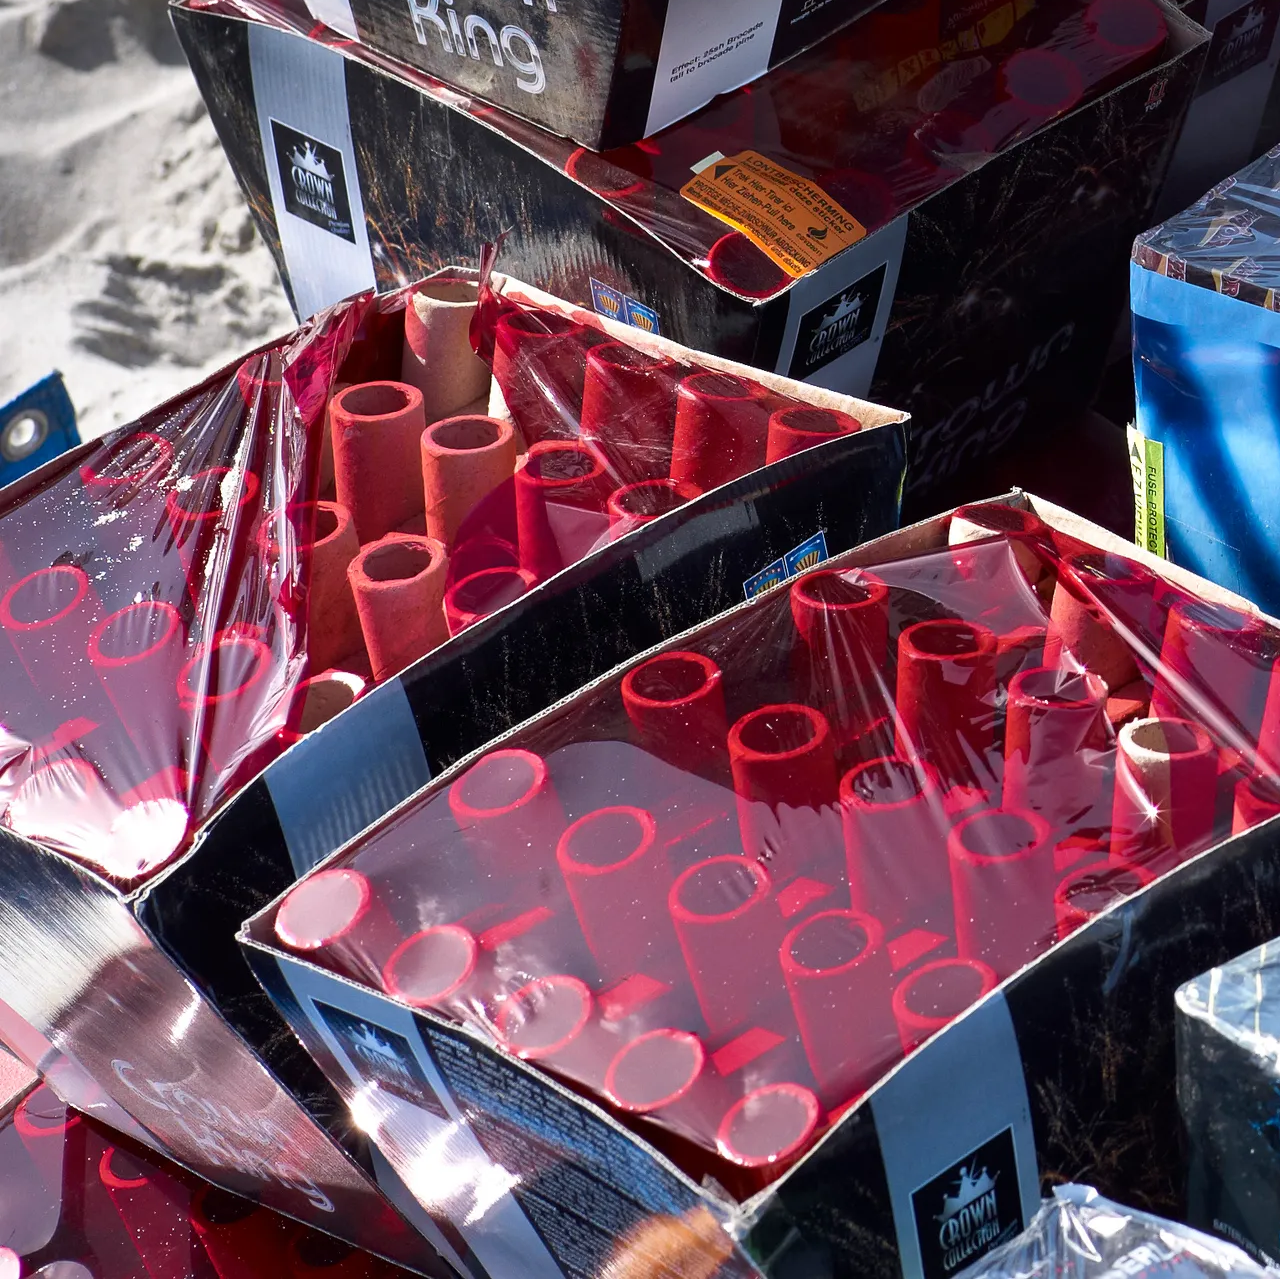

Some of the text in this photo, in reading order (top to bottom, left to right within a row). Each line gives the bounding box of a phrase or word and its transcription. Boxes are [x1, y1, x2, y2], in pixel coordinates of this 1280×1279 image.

[671, 55, 701, 75] Effect:
[727, 21, 764, 46] Brocade
[686, 65, 696, 75] to
[697, 47, 734, 70] brocade
[735, 33, 755, 51] pine
[291, 165, 335, 204] CROWN
[720, 175, 737, 190] Hier
[777, 214, 795, 232] here
[746, 155, 855, 233] LONTBESCHERMING
[789, 186, 813, 207] deze
[809, 307, 860, 353] CROWN
[939, 1189, 998, 1250] CROWN
[943, 1218, 1000, 1271] COLLECTION
